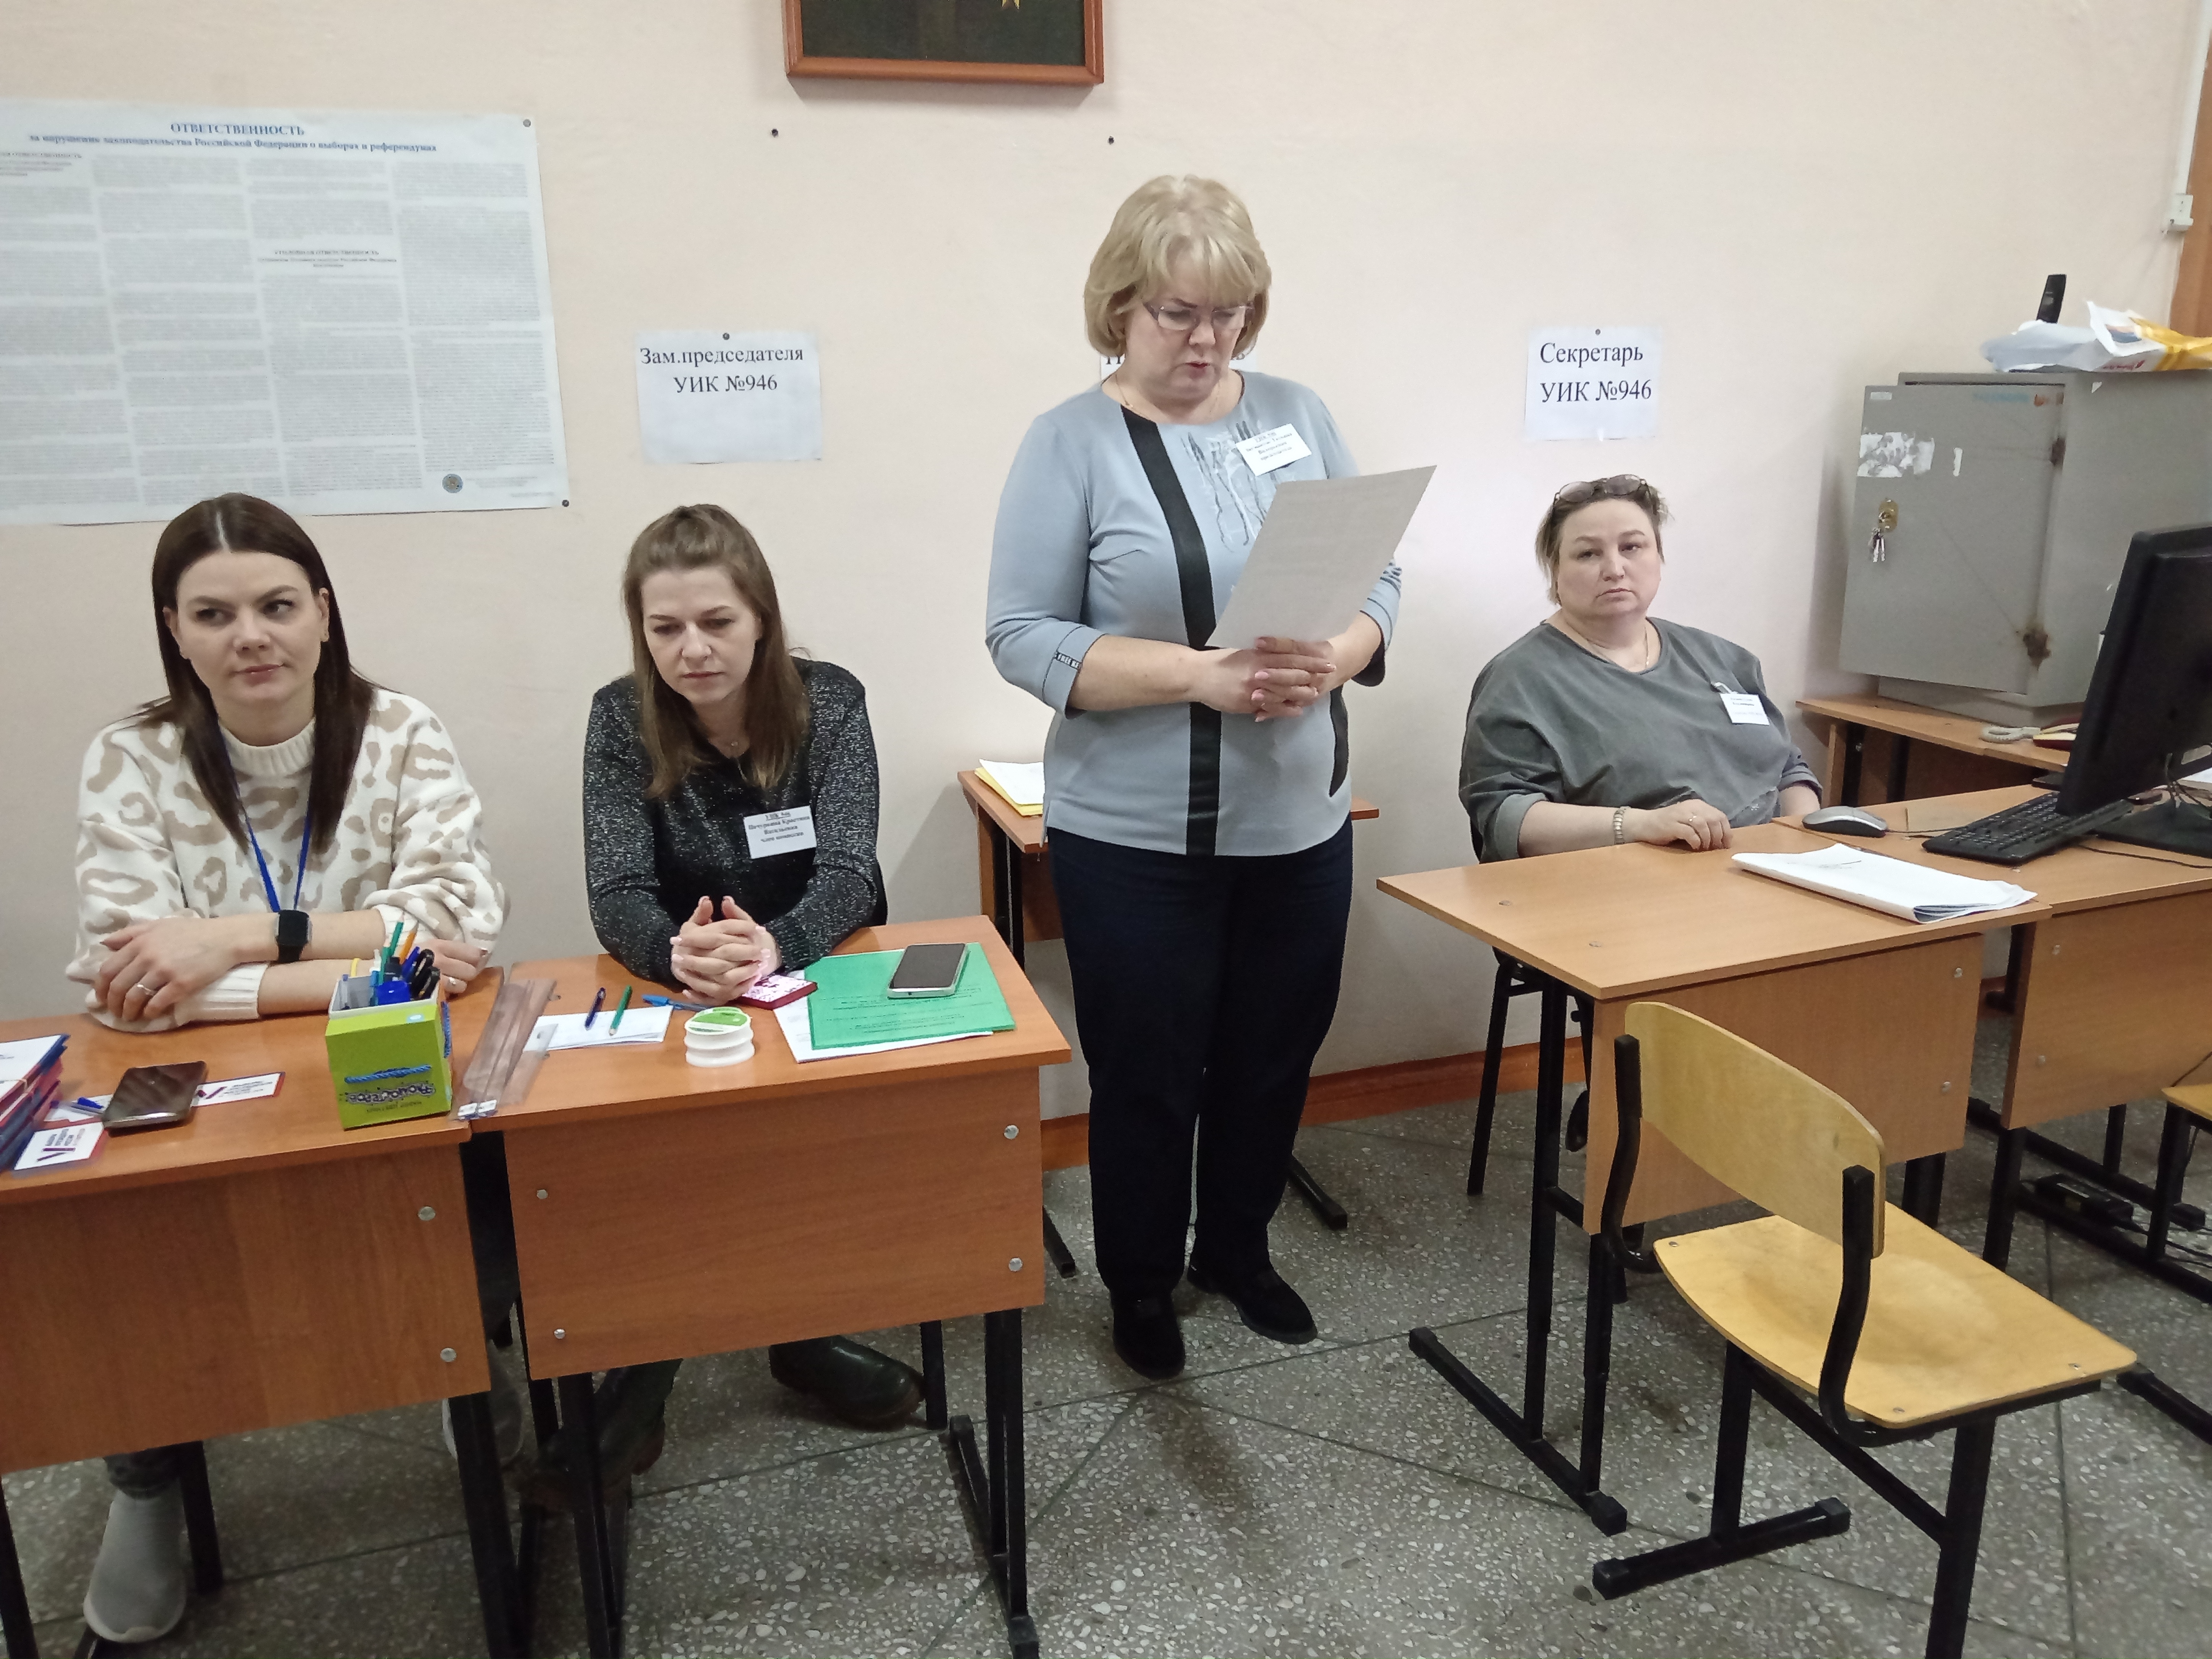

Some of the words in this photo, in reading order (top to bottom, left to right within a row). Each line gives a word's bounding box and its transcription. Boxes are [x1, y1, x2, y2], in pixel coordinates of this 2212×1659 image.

[170, 123, 305, 135] ОТВЕТСТВЕННОСТЬ
[640, 347, 803, 368] Зам.председателя
[1540, 342, 1644, 369] Секретарь
[673, 376, 719, 393] УИК
[725, 374, 778, 391] №946
[1539, 381, 1590, 403] УИК
[1595, 378, 1652, 401] №946
